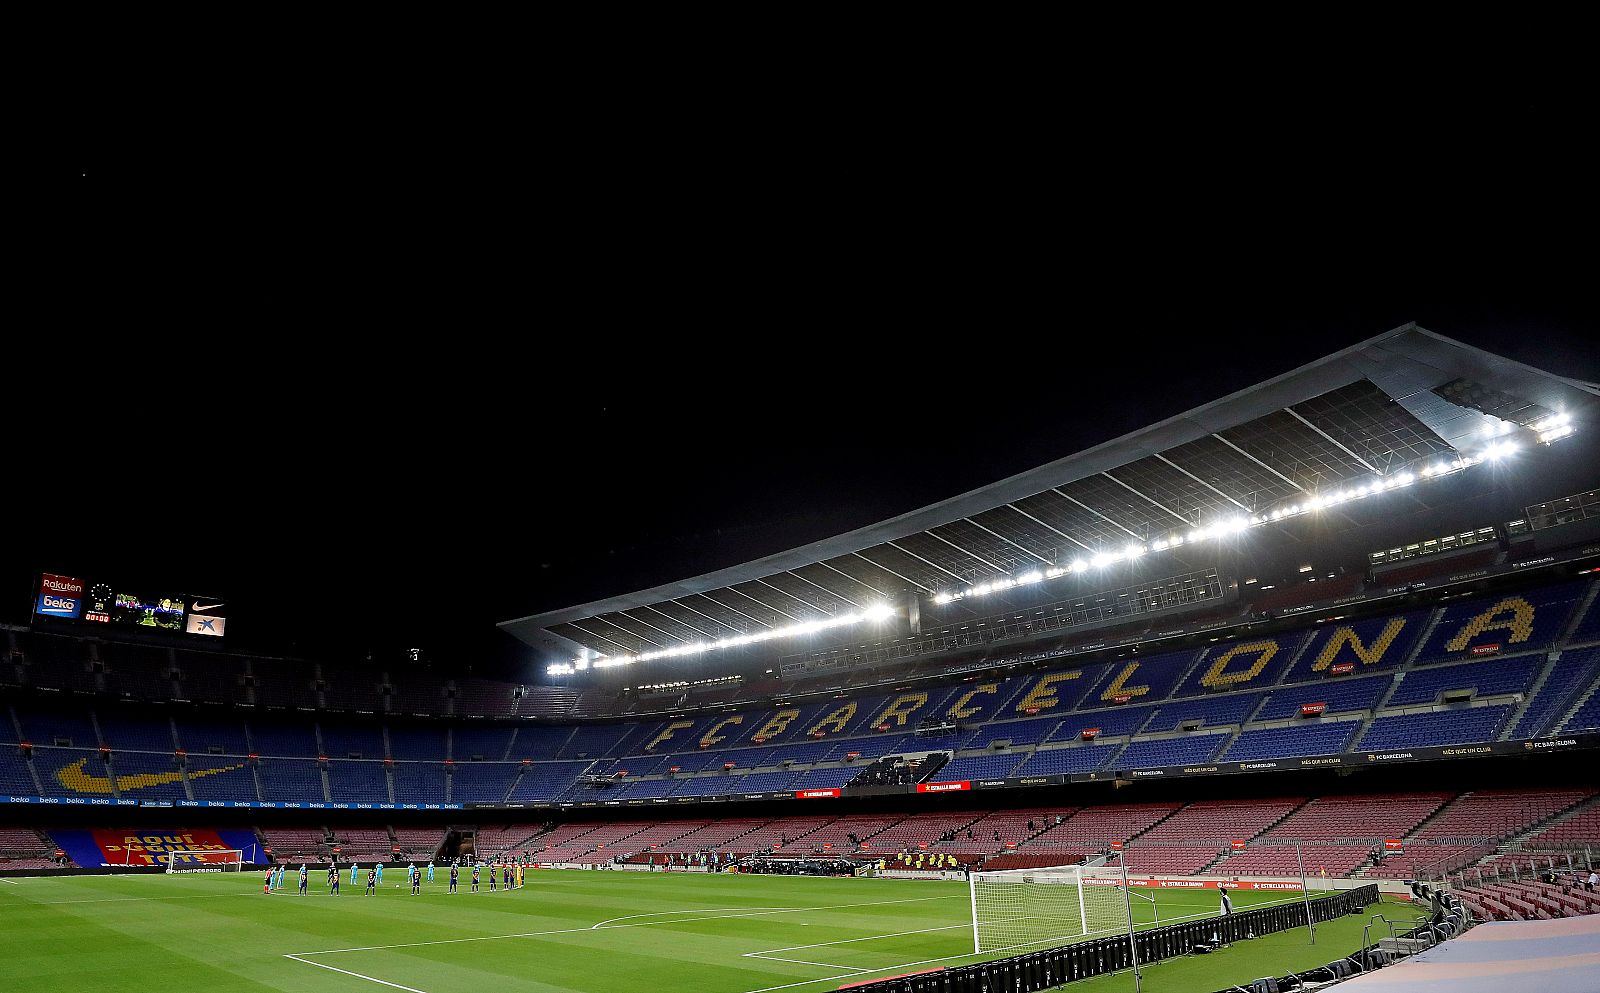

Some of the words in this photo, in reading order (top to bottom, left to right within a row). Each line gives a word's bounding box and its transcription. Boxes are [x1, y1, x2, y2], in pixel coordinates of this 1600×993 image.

[43, 579, 82, 592] Rakuten
[43, 595, 75, 610] beko
[1382, 752, 1413, 760] BARCELONA
